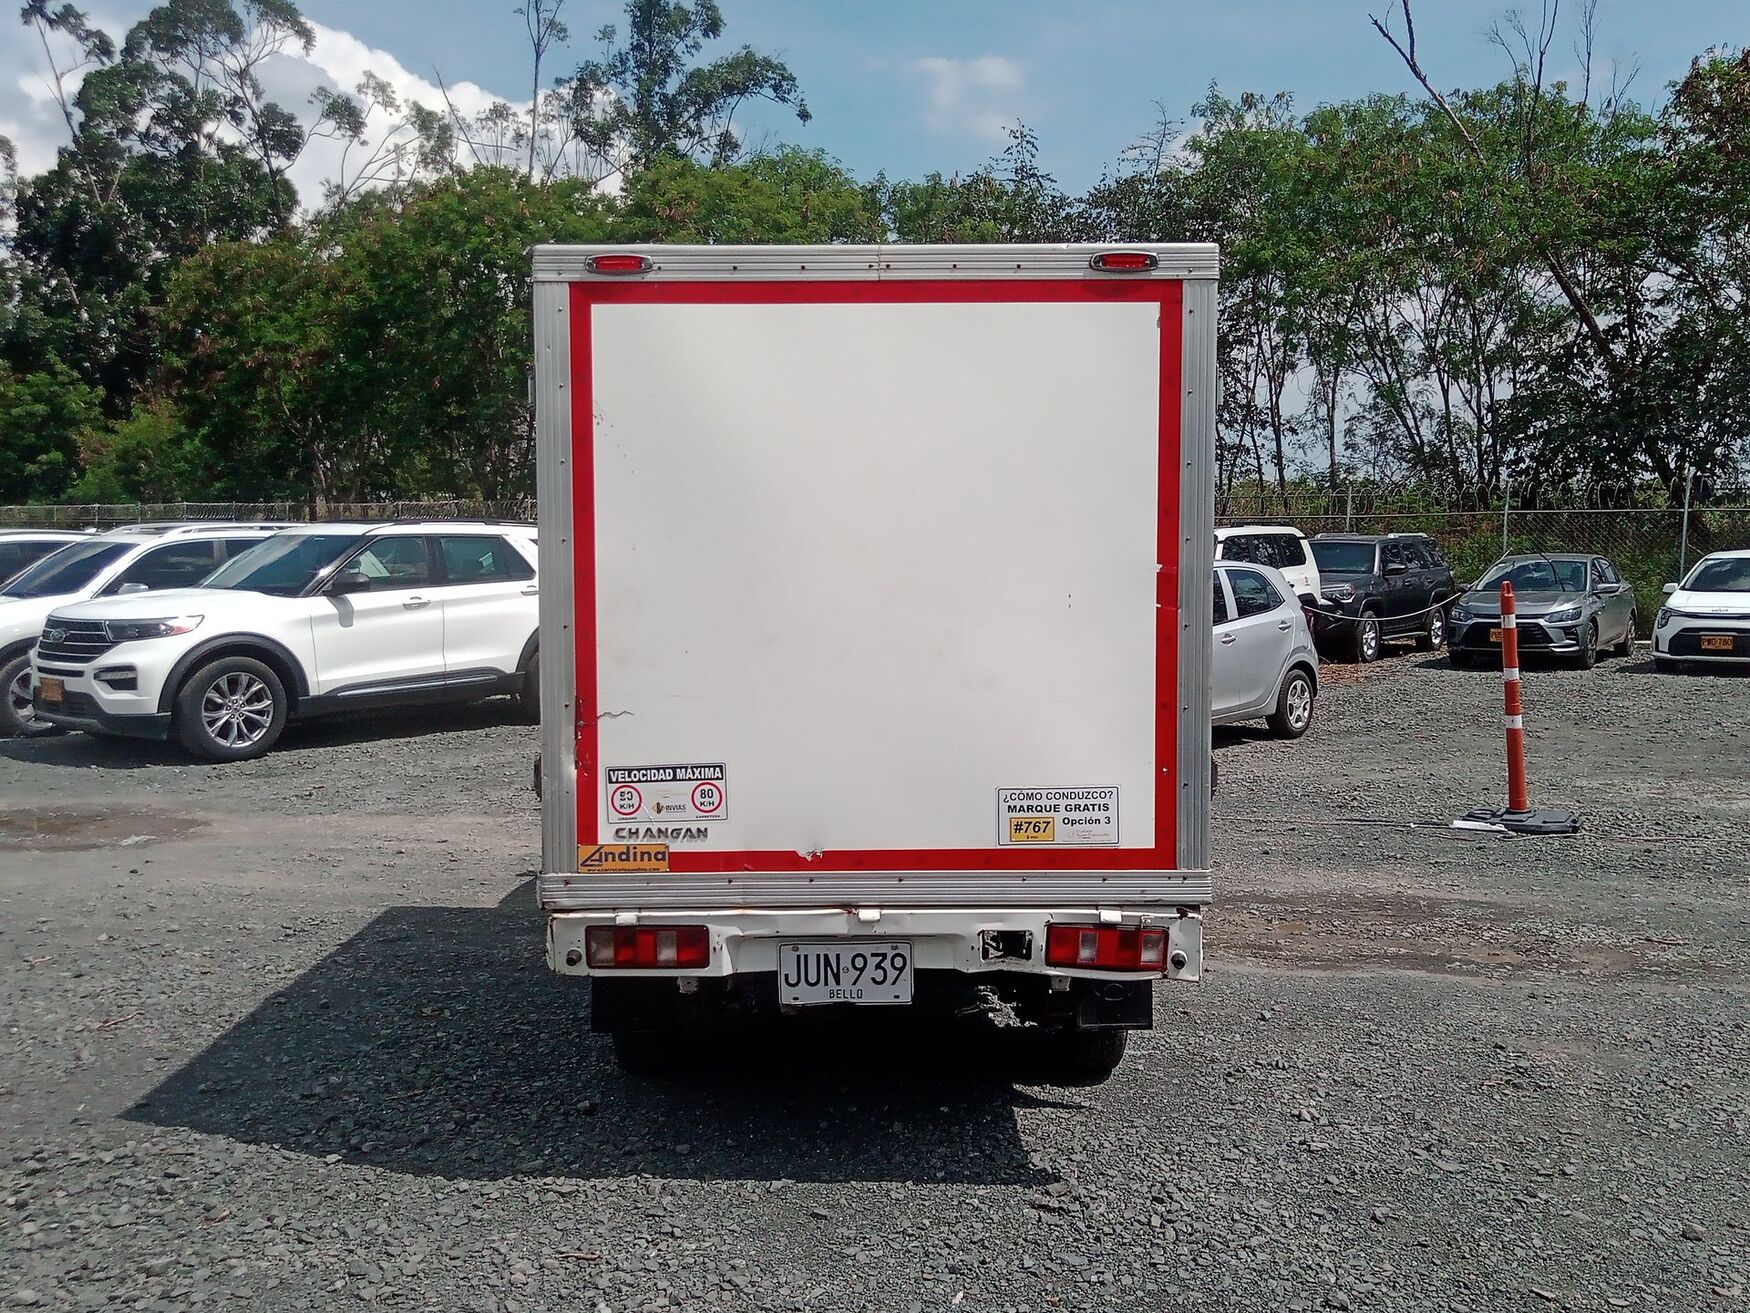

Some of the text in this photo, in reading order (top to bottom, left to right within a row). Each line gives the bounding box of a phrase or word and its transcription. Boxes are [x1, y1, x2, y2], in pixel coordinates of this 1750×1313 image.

[610, 765, 723, 782] VELOCIDAD MÁXIMA
[619, 790, 634, 801] 50
[700, 788, 714, 799] 80
[1003, 790, 1114, 803] ¿CÓMO CONDUZCO?
[1007, 803, 1110, 814] MARQUE GRATIS
[1013, 820, 1052, 834] #767
[1062, 816, 1111, 827] Opción 3
[614, 827, 708, 840] CHANGAN
[580, 845, 667, 867] Andina
[829, 989, 863, 999] BELLO
